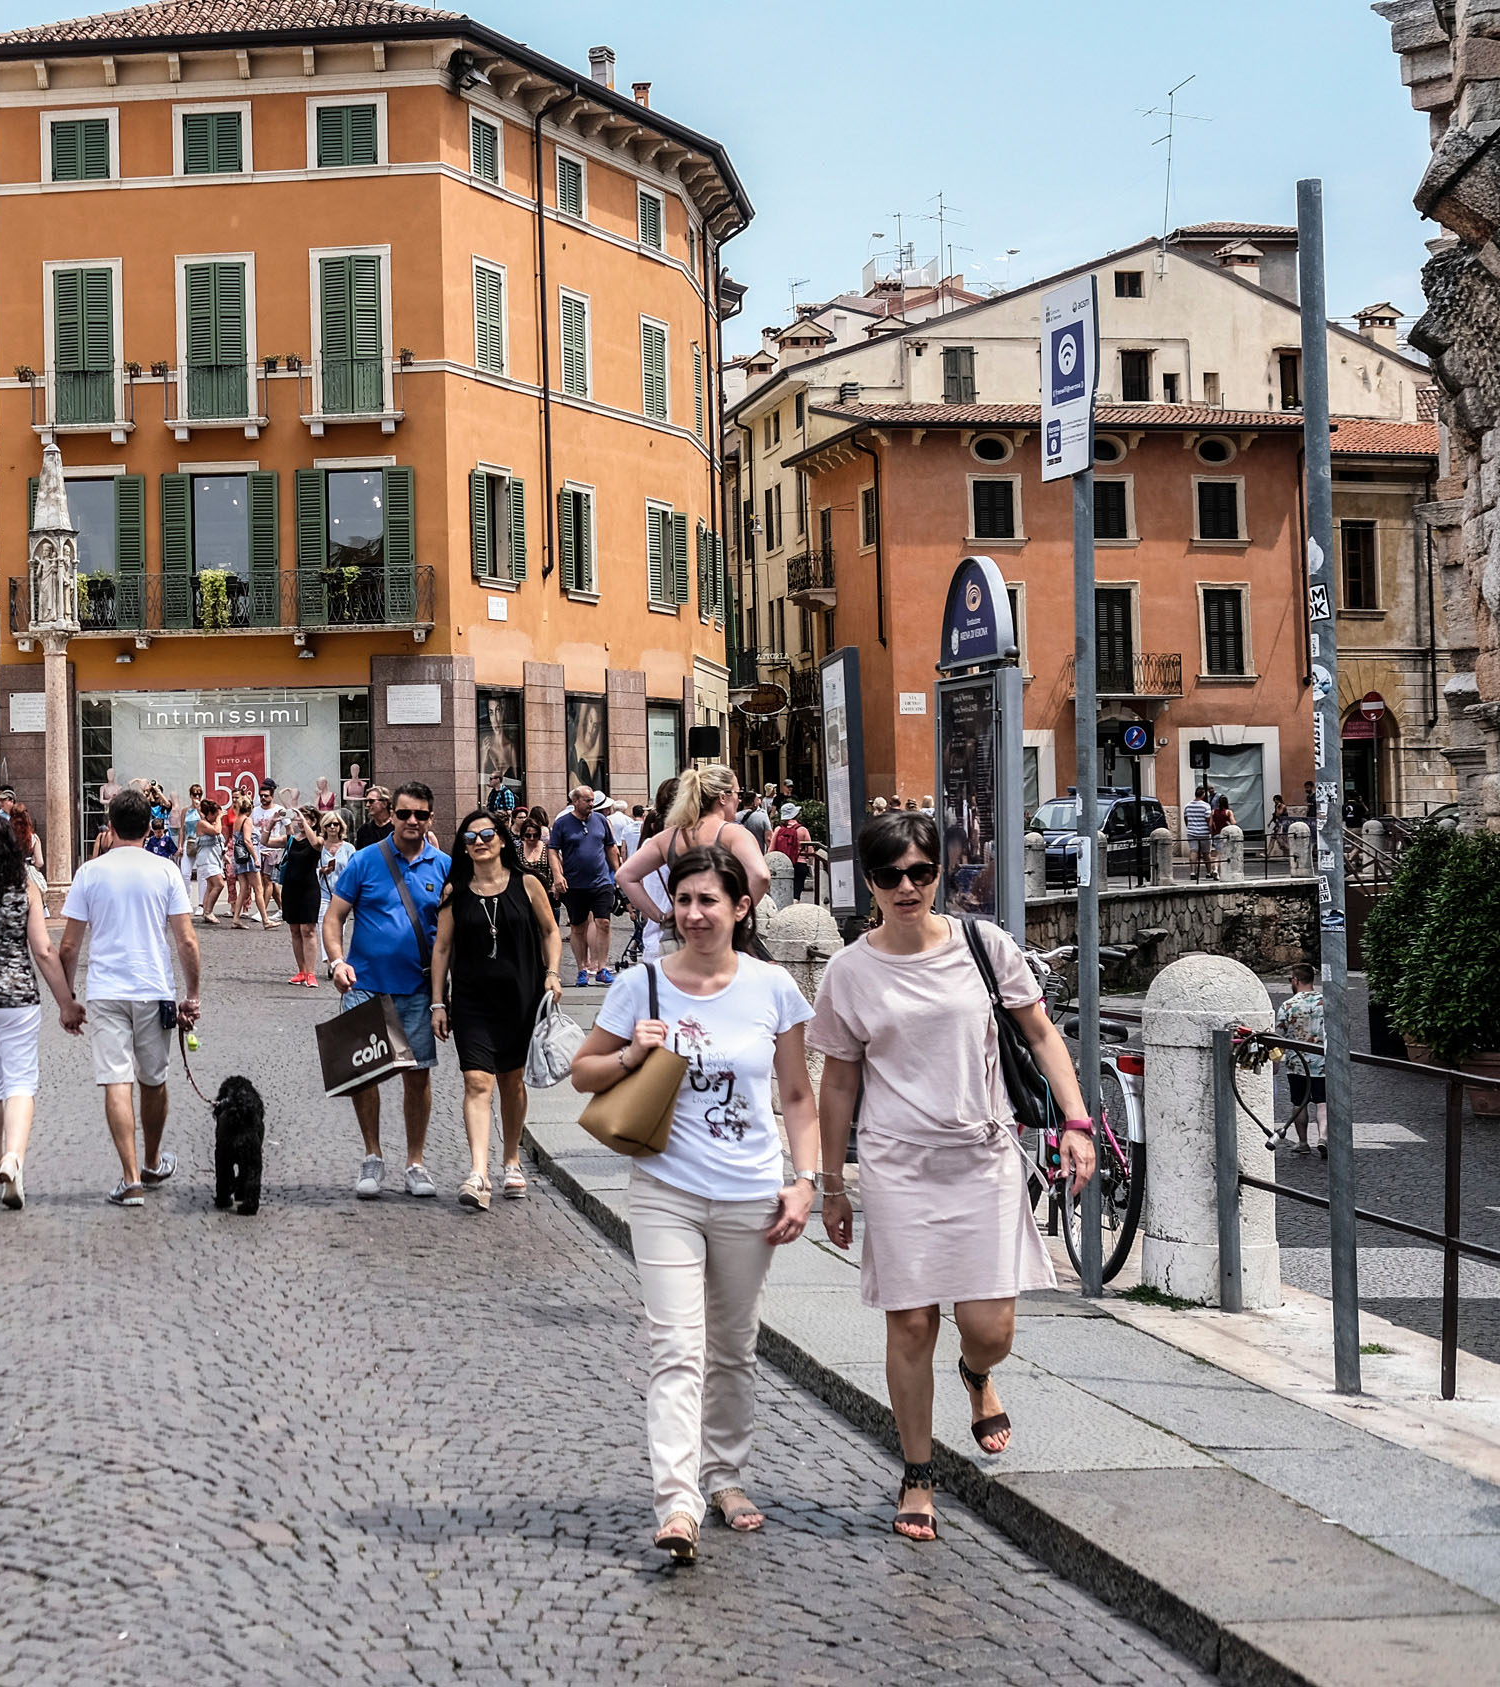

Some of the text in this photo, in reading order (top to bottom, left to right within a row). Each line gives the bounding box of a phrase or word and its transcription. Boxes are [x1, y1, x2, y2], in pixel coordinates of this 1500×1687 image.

[1309, 587, 1326, 603] M
[147, 708, 300, 726] intimissimi
[352, 1033, 389, 1067] coin
